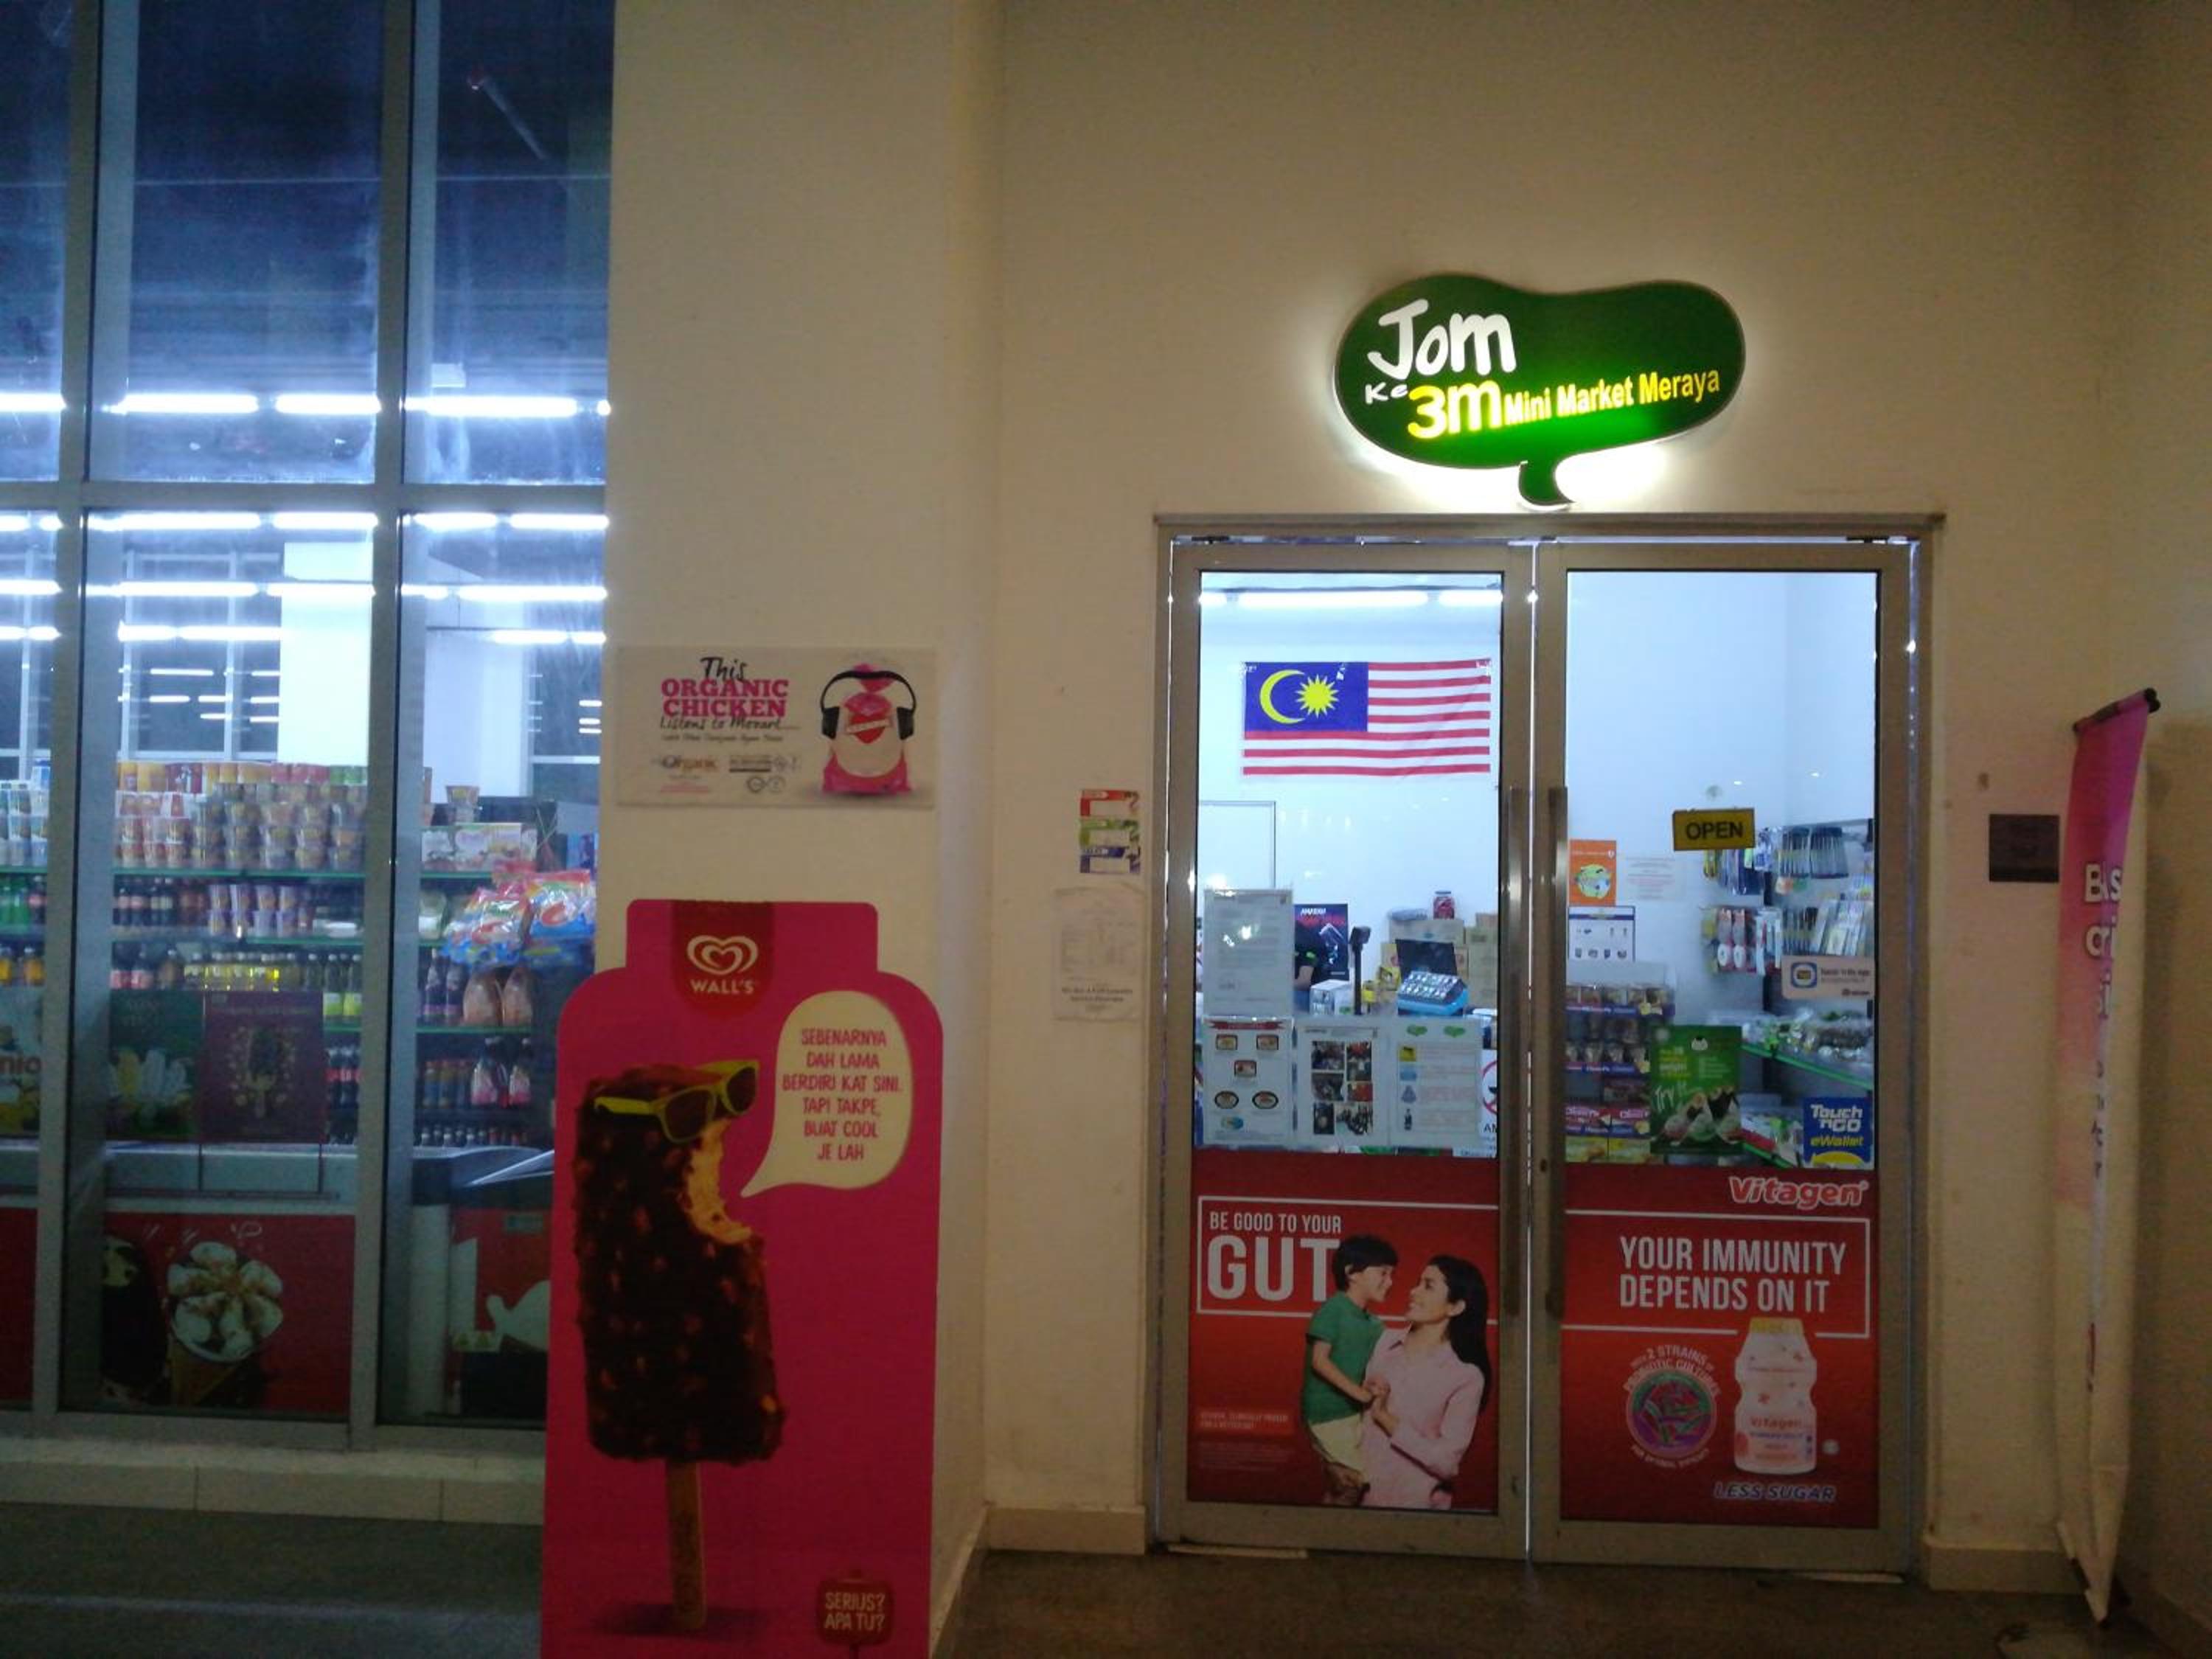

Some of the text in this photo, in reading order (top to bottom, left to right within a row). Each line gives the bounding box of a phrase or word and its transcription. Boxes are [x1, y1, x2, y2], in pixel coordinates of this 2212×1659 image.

[1367, 299, 1517, 380] Jom
[1365, 369, 1721, 438] Ke 3m Mini Market Meraya
[700, 655, 748, 681] This
[661, 678, 789, 698] ORGANIC
[663, 699, 787, 718] CHICKEN
[1686, 821, 1744, 841] OPEN
[690, 978, 755, 995] WALL'S
[801, 1027, 886, 1046] SEBENARNYA
[805, 1052, 880, 1070] DAH LAMA
[782, 1074, 836, 1091] BERDIRI
[841, 1075, 868, 1092] KAT
[803, 1097, 832, 1115] TAPI
[1810, 1105, 1863, 1119] Touch
[804, 1120, 878, 1138] BUAT COOL
[1810, 1135, 1865, 1147] eWallet
[817, 1144, 864, 1161] JE LAH
[1728, 1176, 1864, 1211] Vitagen
[1210, 1211, 1341, 1234] BE GOOD TO YOUR
[1619, 1236, 1846, 1275] YOUR IMMUNITY
[1206, 1234, 1340, 1302] GUT
[1620, 1274, 1830, 1312] DEPENDS ON IT
[1712, 1480, 1837, 1503] LESS SUGAR
[825, 1592, 886, 1612] SERIUS?
[824, 1612, 886, 1632] APA TU?
